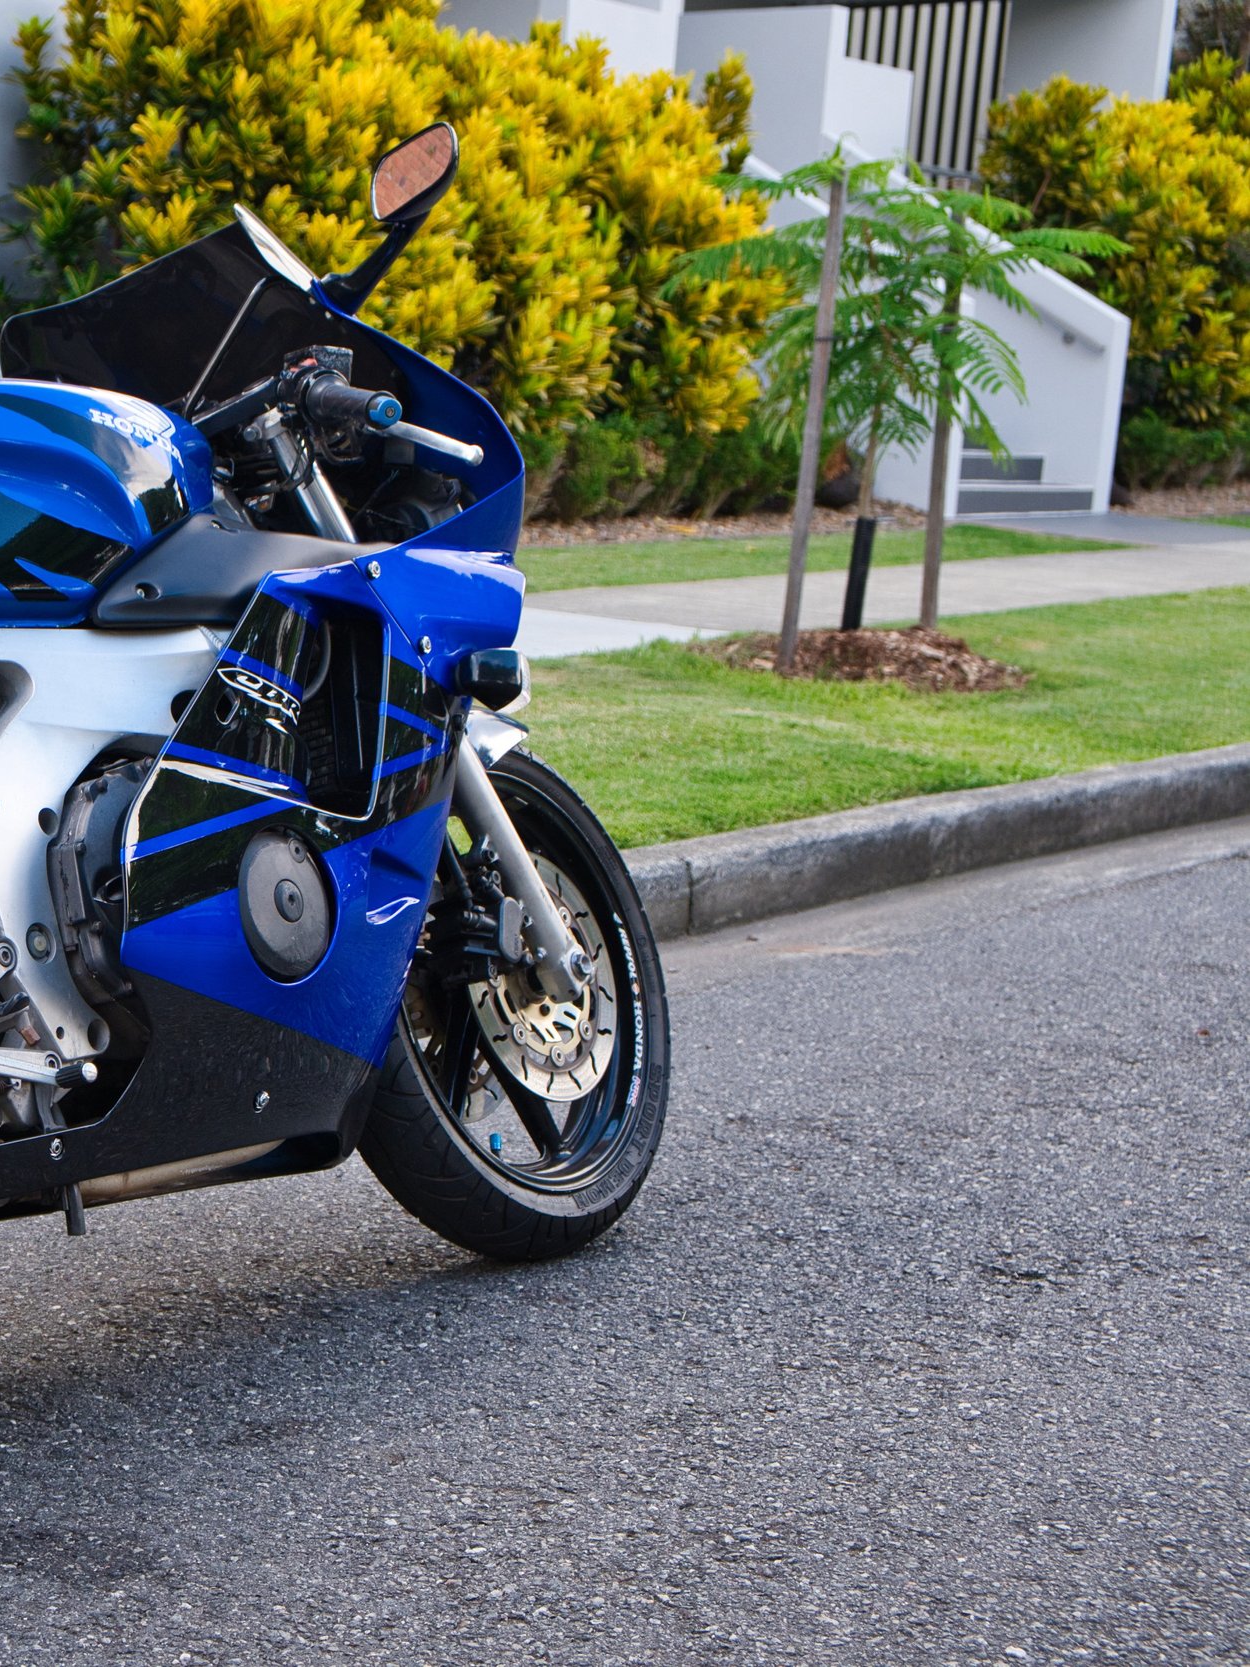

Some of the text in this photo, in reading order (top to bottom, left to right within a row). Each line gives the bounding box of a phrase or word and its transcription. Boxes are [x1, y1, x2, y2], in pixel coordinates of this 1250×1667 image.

[633, 1001, 644, 1070] HONDA
[572, 1062, 663, 1210] SPORT DEMON
